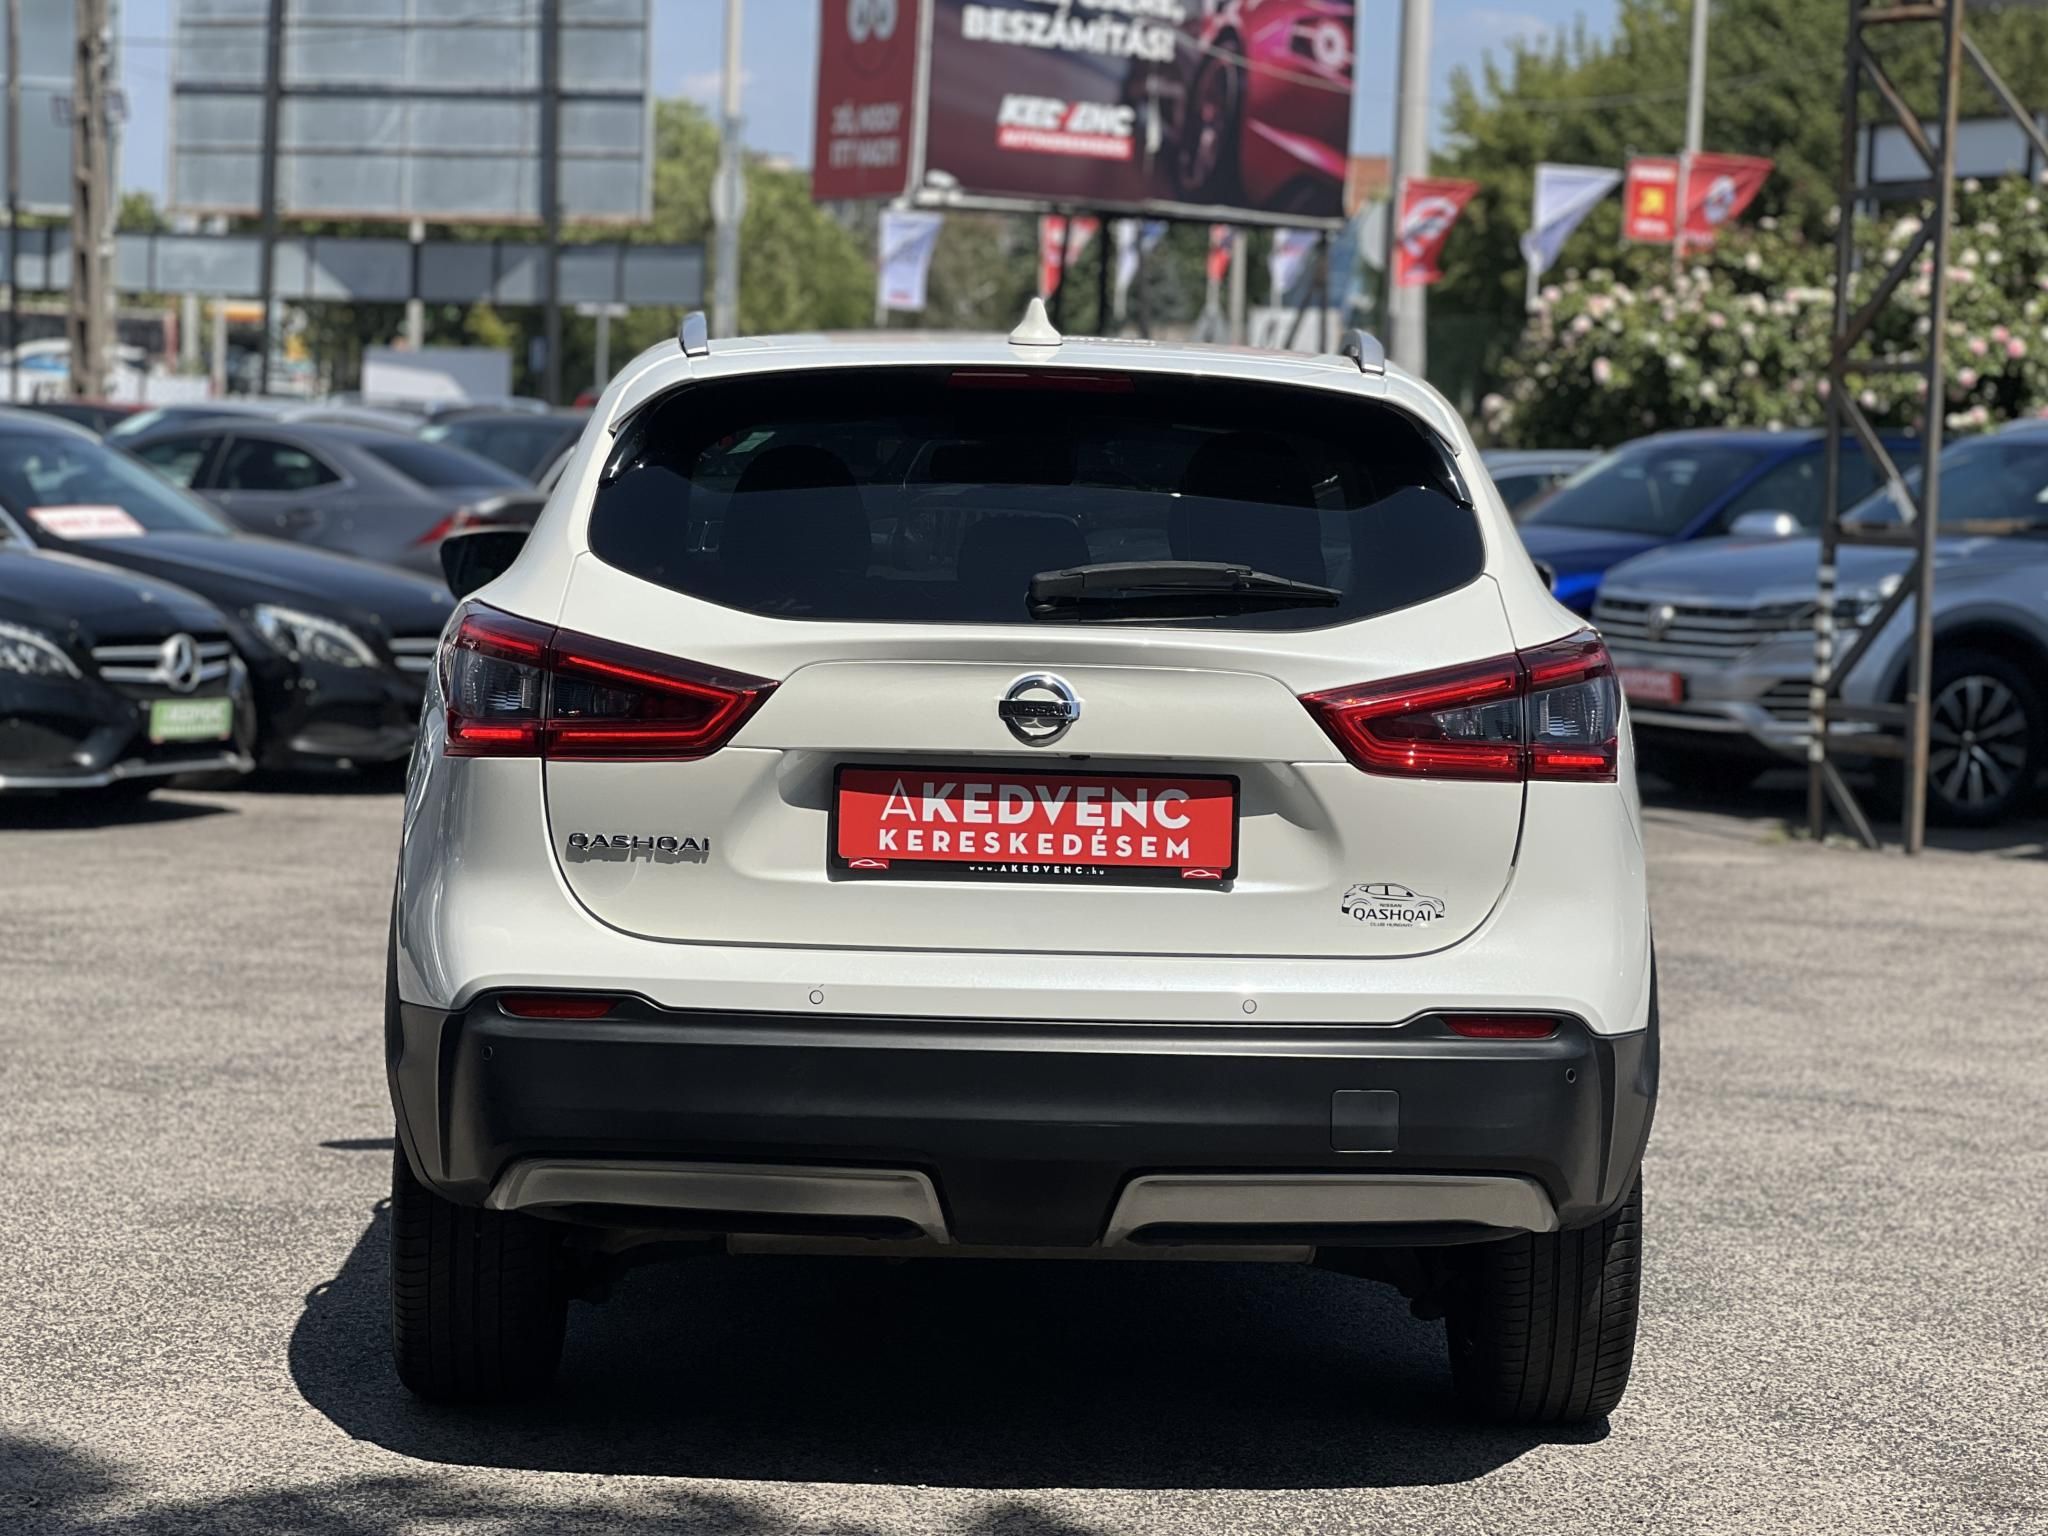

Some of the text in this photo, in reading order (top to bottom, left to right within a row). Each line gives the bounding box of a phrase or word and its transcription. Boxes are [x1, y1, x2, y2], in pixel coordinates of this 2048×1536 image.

[1005, 703, 1073, 717] NISSAN
[568, 832, 710, 855] QASHQAI
[878, 828, 1190, 859] KERESKEDÉSEM
[1353, 907, 1431, 922] QASHQAI
